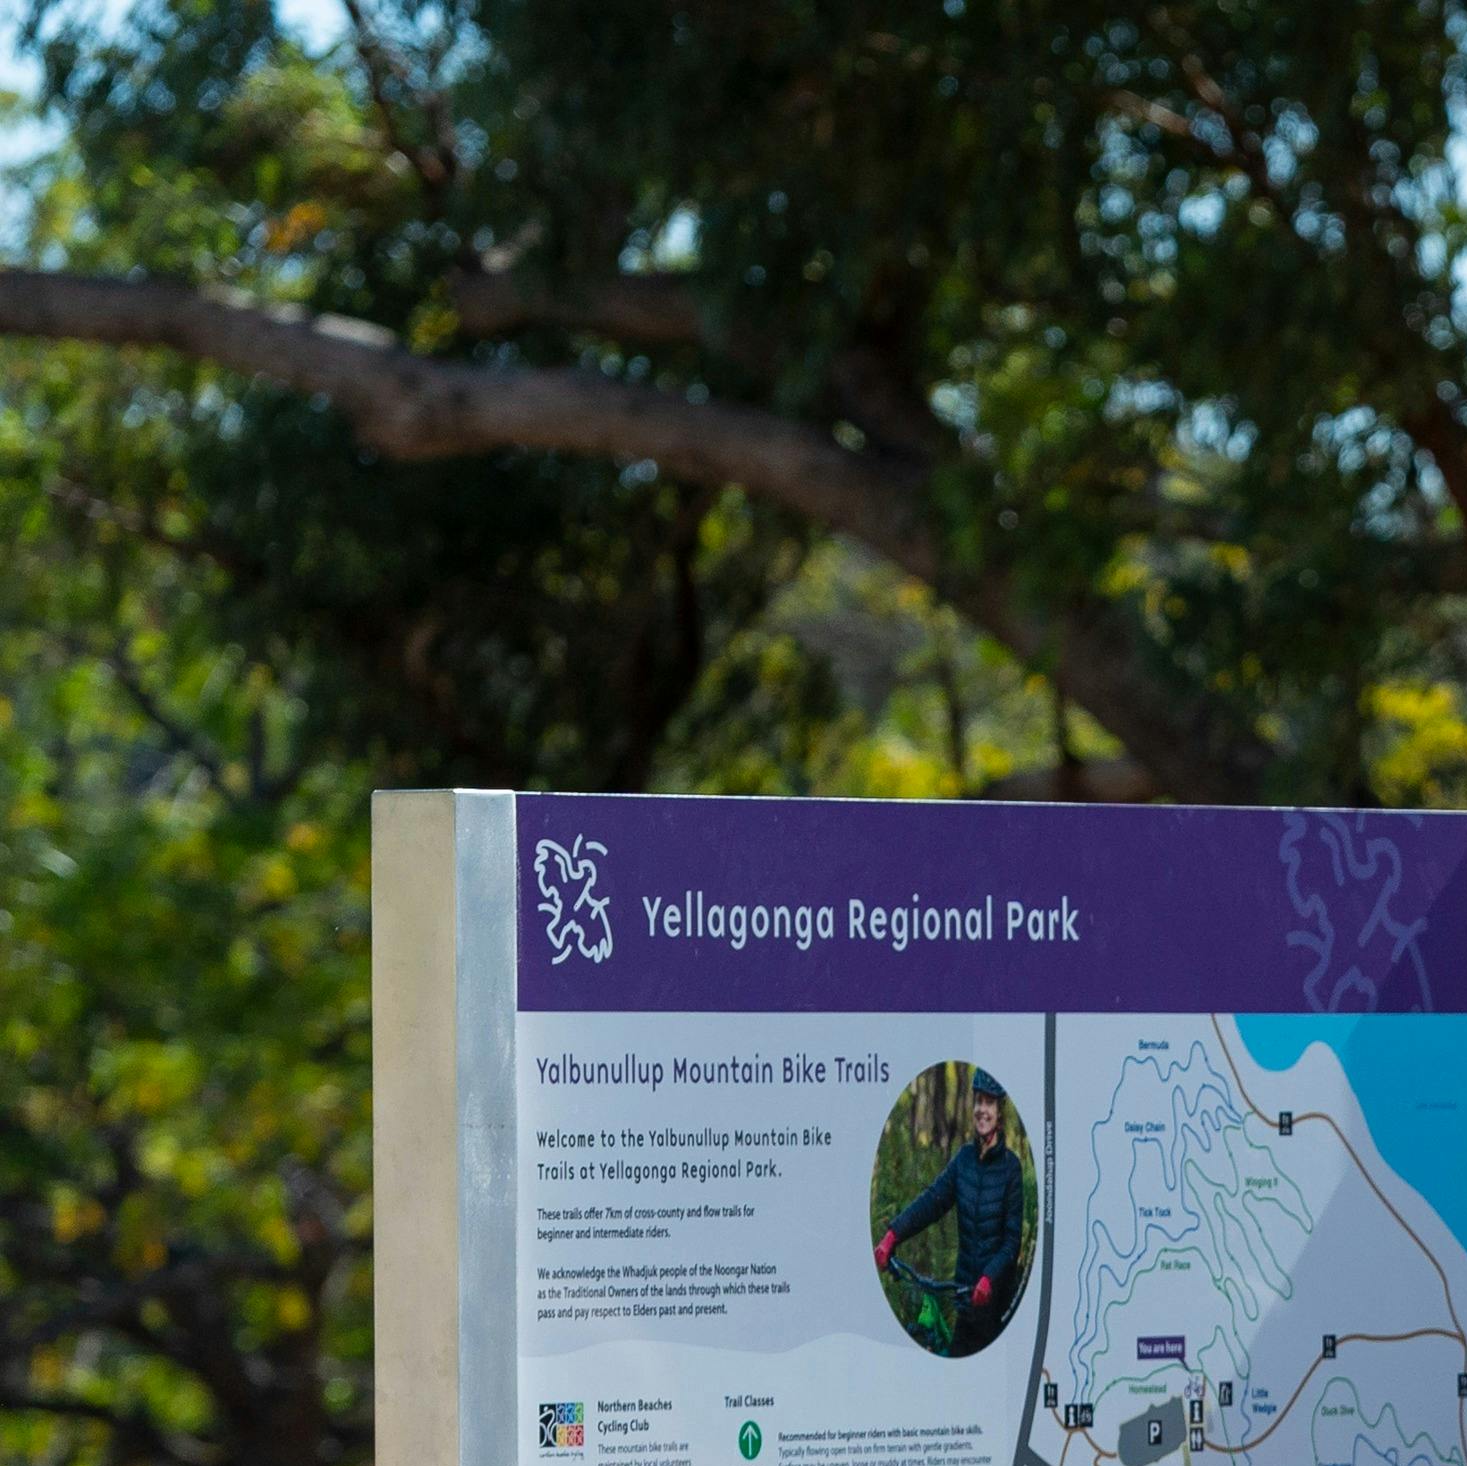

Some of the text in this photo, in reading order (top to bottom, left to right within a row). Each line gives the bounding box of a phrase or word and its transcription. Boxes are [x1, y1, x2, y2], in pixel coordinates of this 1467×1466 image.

[642, 891, 1080, 951] Yellagonga Regional Park
[1138, 1039, 1169, 1050] Bermuda
[536, 1053, 889, 1092] Yalbunullup Mountain Bike Trails
[1145, 1122, 1165, 1132] Chain
[536, 1127, 831, 1147] Welcome to the Yalbunullup Mountain Bike
[538, 1159, 781, 1183] Trails at Yellagonga Regional Park.
[537, 1204, 754, 1220] These trails offer 7km of cross-county and flow trails for
[536, 1225, 670, 1242] beginner and intermediate riders.
[537, 1262, 776, 1281] We acknowledge the Whadjuk people of the Noongar Nation
[537, 1281, 790, 1299] as the Traditional Owners of the lands through which these trails
[537, 1302, 727, 1321] pass and pay respect to Elders past and present.
[1139, 1342, 1183, 1354] You are here
[1128, 1384, 1167, 1394] Homestead
[597, 1398, 672, 1412] Northern Beaches
[725, 1394, 774, 1407] Trail Classes
[597, 1419, 649, 1435] Cycling Club
[1150, 1423, 1160, 1441] P
